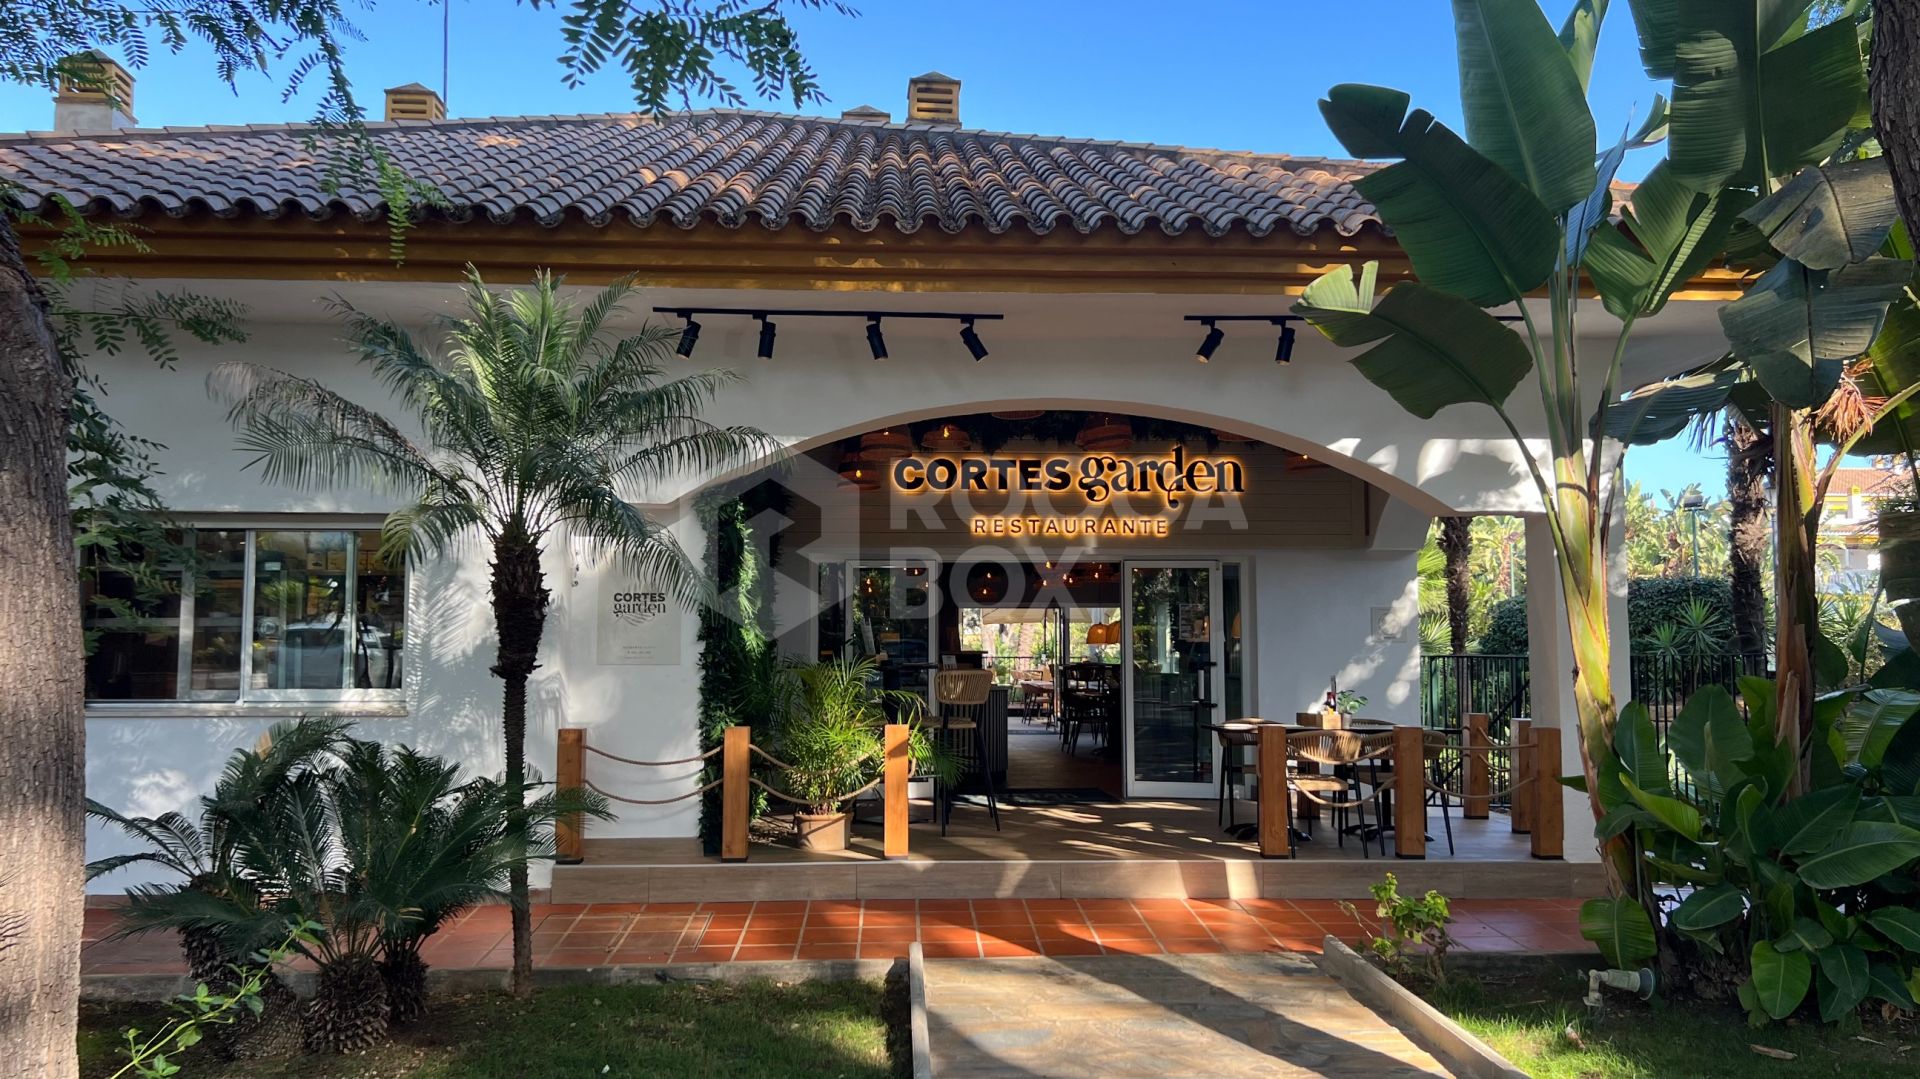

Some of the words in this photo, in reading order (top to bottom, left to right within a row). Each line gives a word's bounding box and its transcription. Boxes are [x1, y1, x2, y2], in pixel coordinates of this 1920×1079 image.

[893, 458, 1072, 491] CORTES
[1078, 446, 1245, 508] garden
[973, 518, 1169, 535] RESTAURANTE
[613, 592, 666, 602] CORTES
[613, 601, 666, 617] garden
